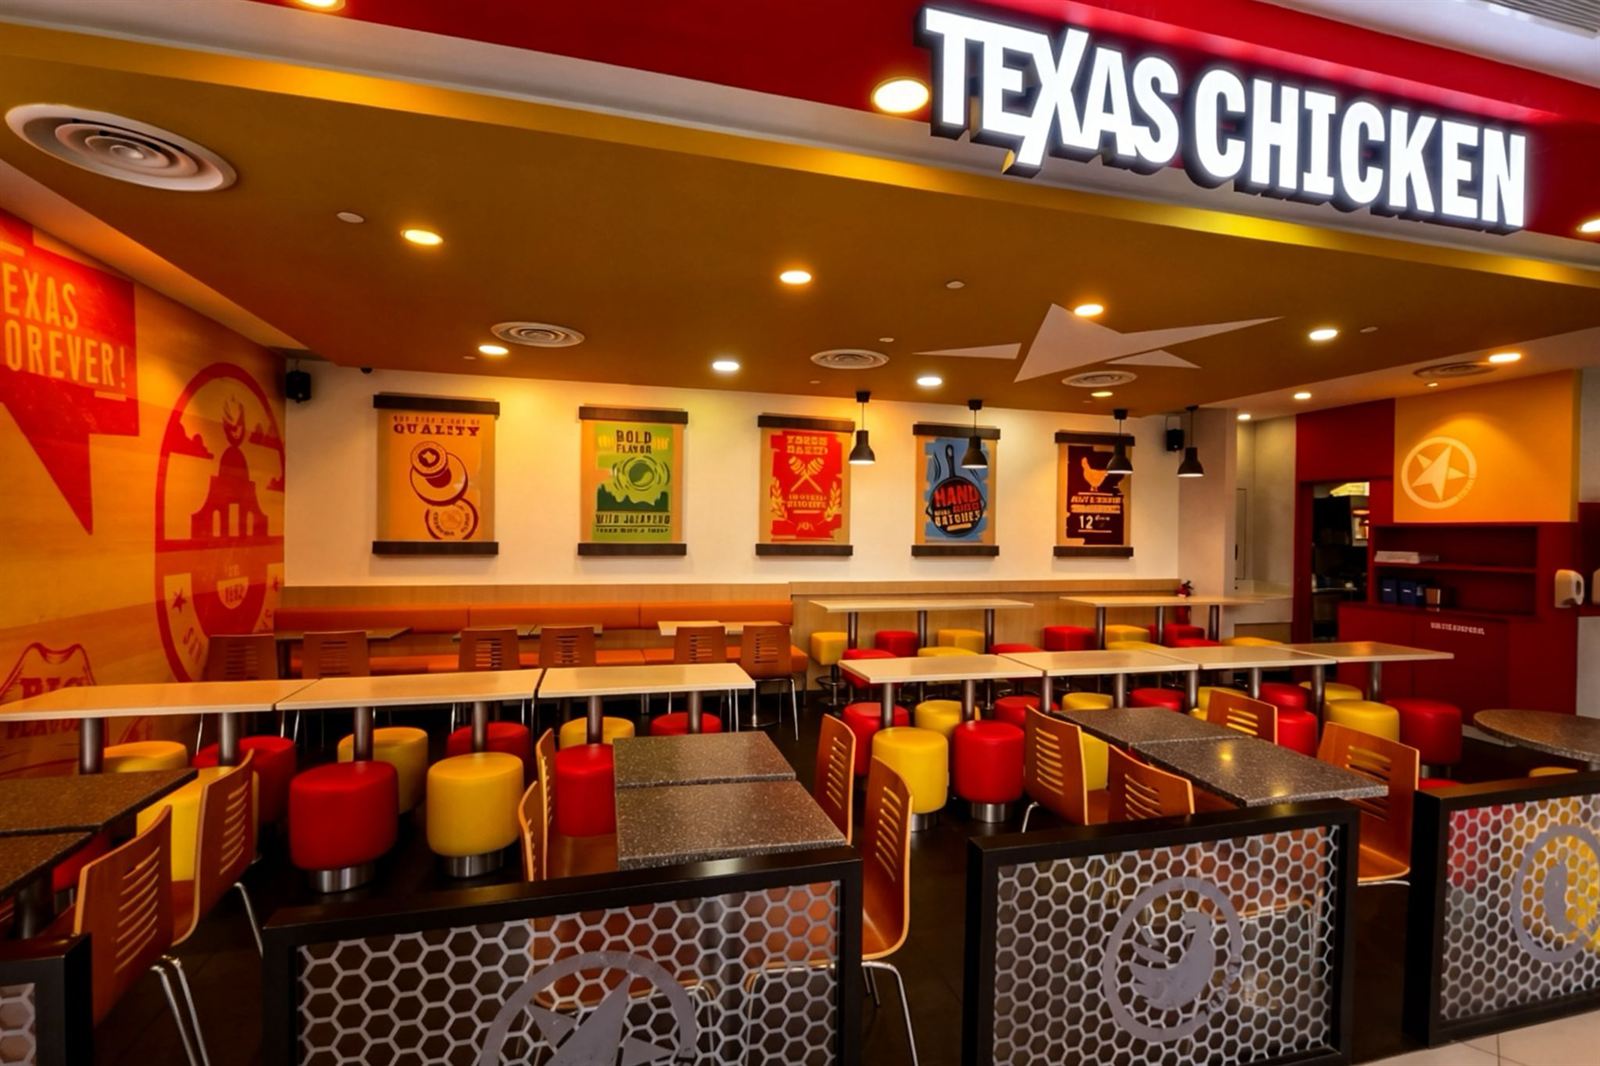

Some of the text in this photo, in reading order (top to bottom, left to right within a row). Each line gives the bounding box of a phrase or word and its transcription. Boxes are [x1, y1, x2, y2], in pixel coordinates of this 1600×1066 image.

[925, 8, 1527, 228] TEXAS CHICKEN
[2, 263, 78, 330] EXAS
[5, 319, 127, 389] OREVER!
[393, 423, 480, 437] QUALITY
[616, 430, 652, 444] BOLD
[616, 444, 652, 454] FLAVOR
[1079, 515, 1094, 529] 12
